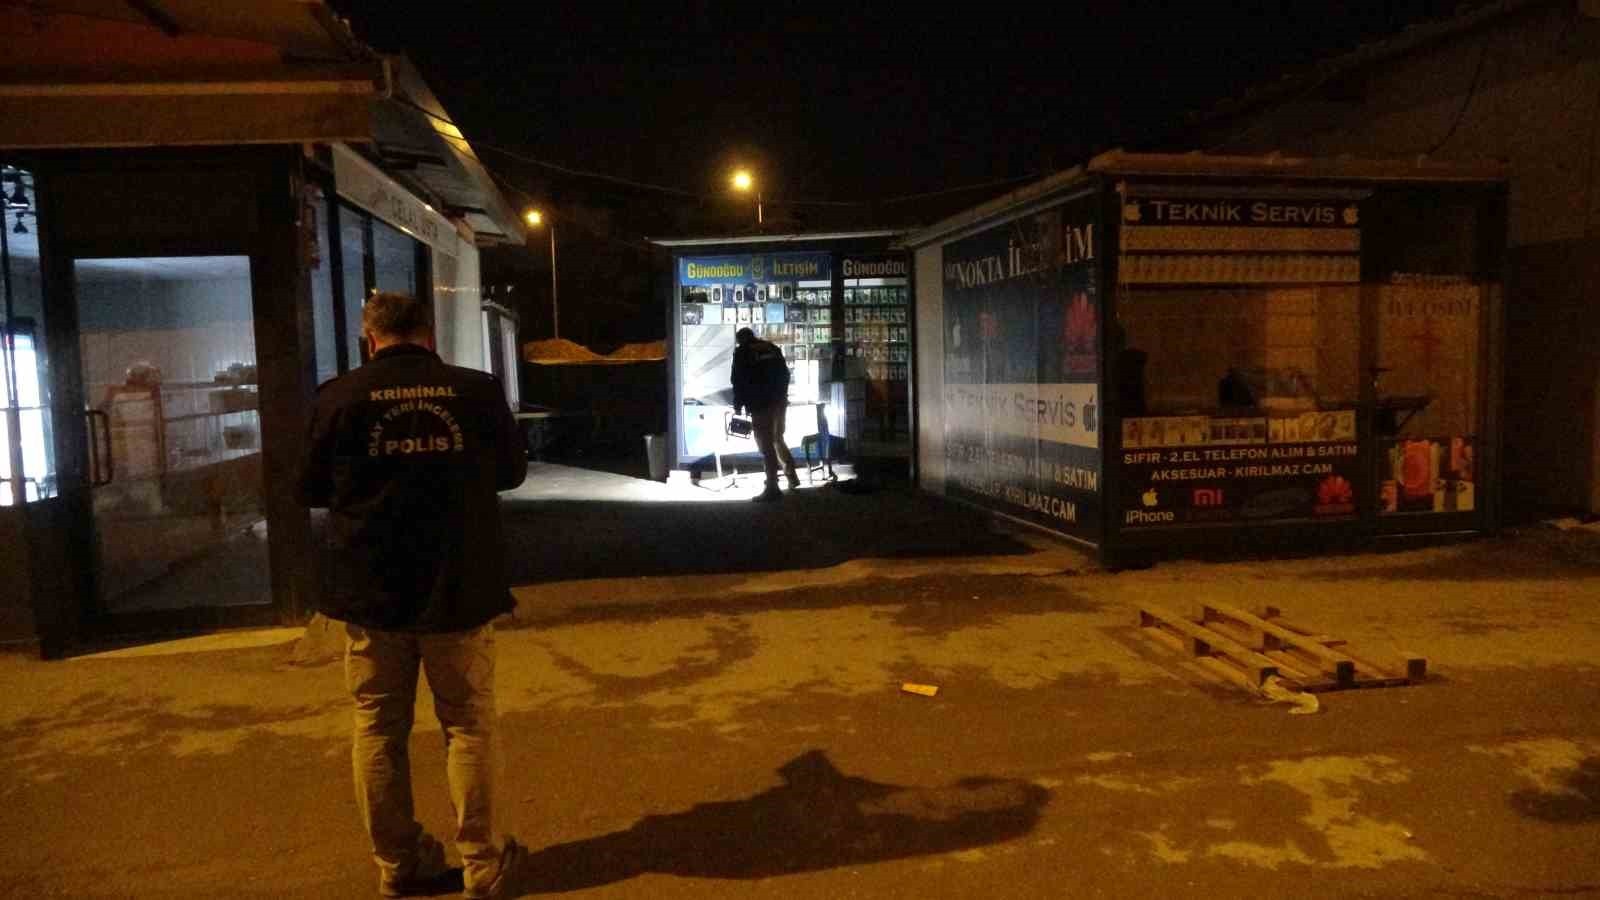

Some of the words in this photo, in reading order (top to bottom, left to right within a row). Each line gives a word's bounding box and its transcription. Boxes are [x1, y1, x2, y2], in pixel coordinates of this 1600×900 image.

[1150, 199, 1241, 222] TEKNİK
[1249, 201, 1337, 224] SERVİS
[957, 256, 1005, 289] NOKTA
[1014, 391, 1076, 428] SERVİS
[1205, 447, 1268, 461] TELEFON
[1271, 446, 1303, 458] ALIM
[1318, 444, 1358, 457] SATIM
[1063, 464, 1098, 492] SATIM
[1151, 466, 1226, 481] AKSESUAR
[1235, 464, 1301, 478] KIRILMAZ
[1303, 462, 1333, 475] CAM
[1051, 496, 1077, 521] CAM
